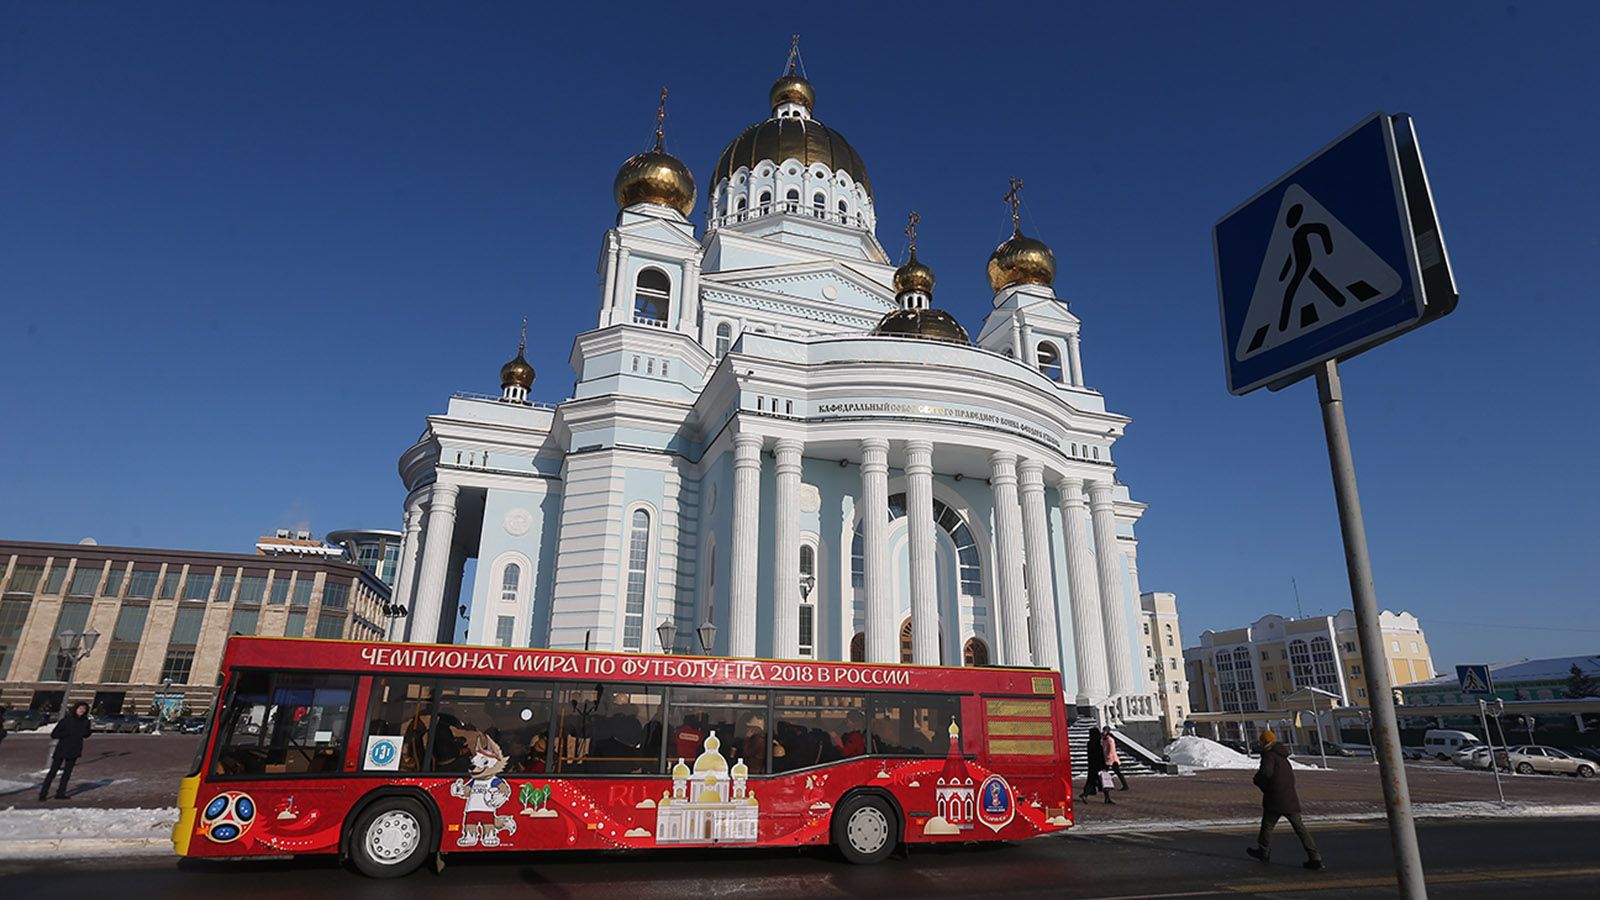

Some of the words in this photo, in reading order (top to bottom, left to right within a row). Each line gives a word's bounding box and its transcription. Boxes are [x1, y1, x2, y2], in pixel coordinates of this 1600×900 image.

[818, 402, 890, 413] КАФЕДРАЛЬНЫЙ
[361, 648, 508, 670] ЧЕМПИОНАТ
[513, 654, 579, 673] МИРА
[585, 657, 616, 675] ПО
[621, 658, 719, 679] ФУТБОЛУ
[724, 662, 765, 680] FIFA
[770, 665, 814, 682] 2018
[818, 667, 831, 682] В
[834, 668, 911, 685] РОССИИ
